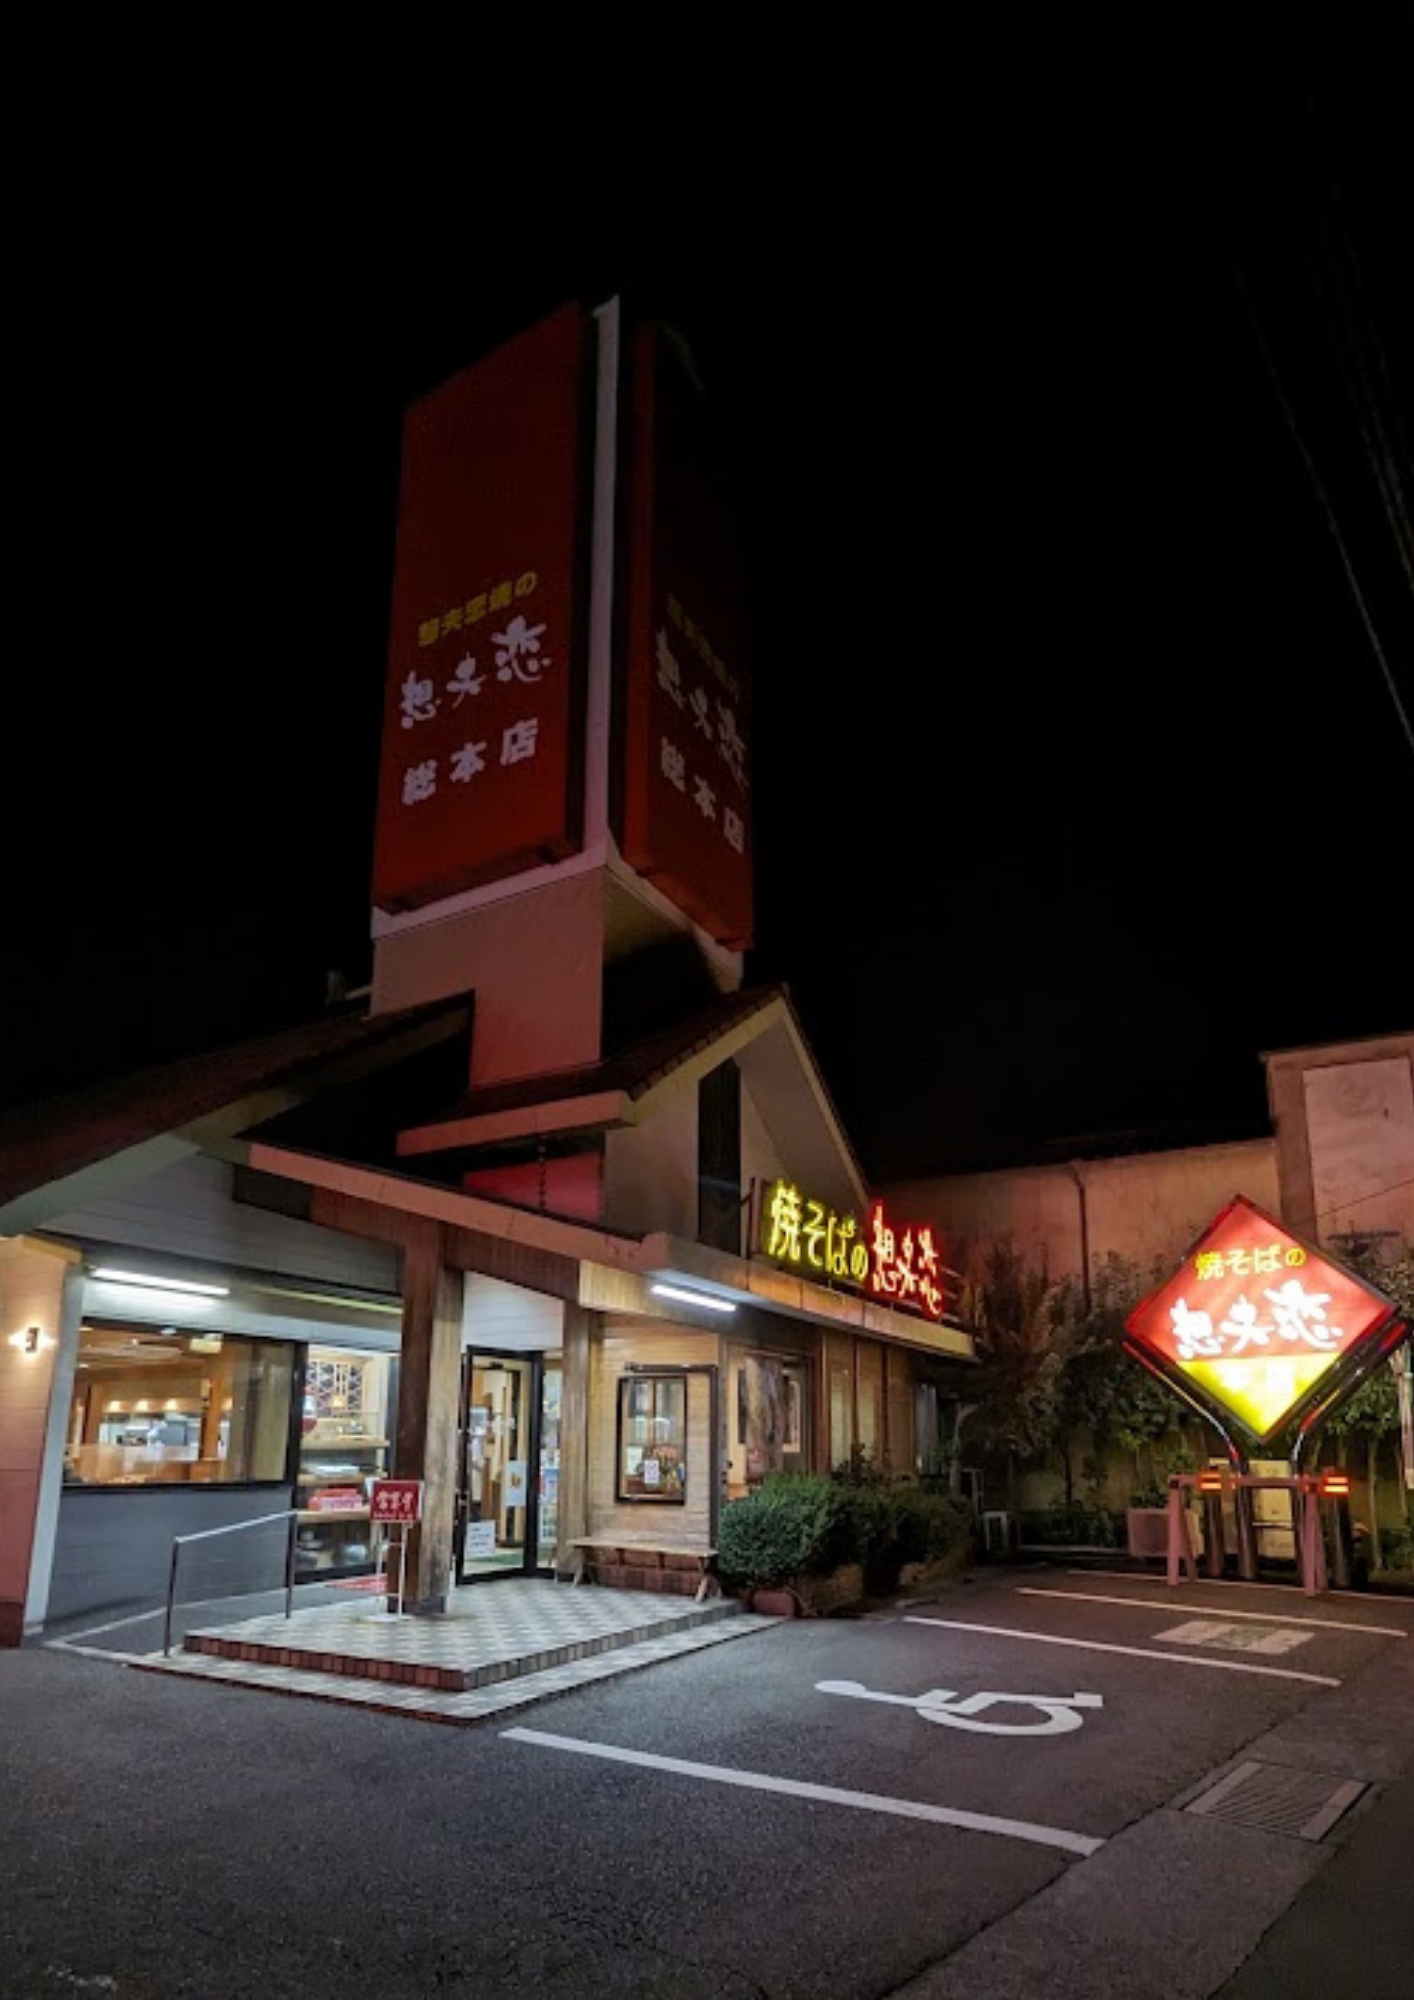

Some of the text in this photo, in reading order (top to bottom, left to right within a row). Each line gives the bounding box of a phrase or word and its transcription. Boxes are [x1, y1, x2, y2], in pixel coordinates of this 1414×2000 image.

[401, 718, 538, 806] 総本店
[1195, 1244, 1306, 1279] 焼そばの
